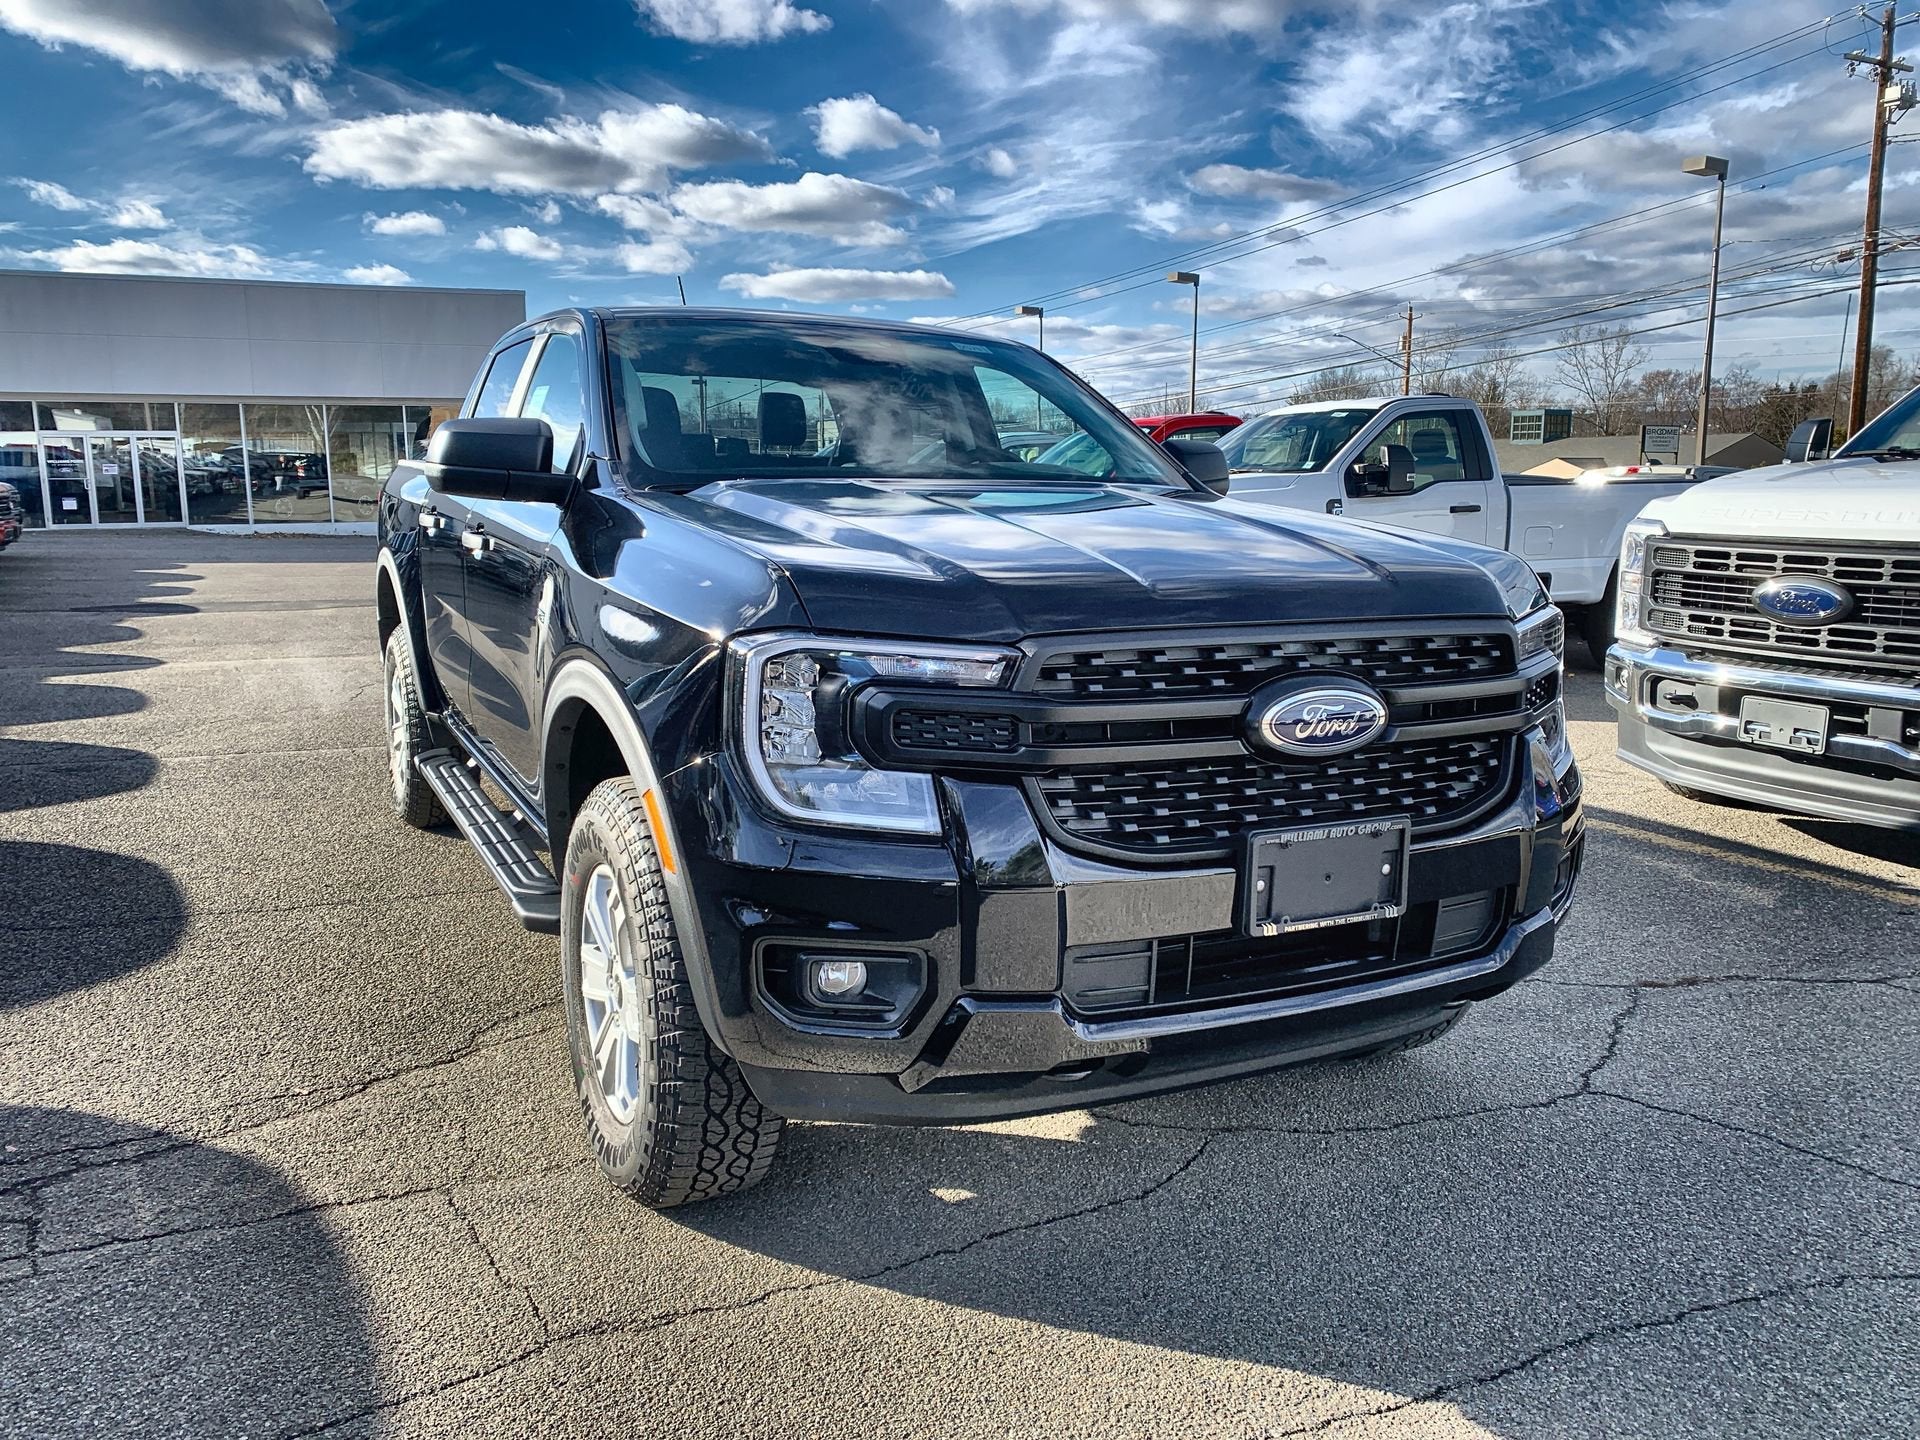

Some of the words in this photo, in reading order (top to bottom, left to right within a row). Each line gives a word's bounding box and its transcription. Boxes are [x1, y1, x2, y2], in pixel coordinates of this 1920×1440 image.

[1646, 428, 1678, 436] BROOME
[1774, 589, 1821, 612] Ford
[1295, 704, 1361, 739] Ford
[1330, 826, 1356, 838] AUTO
[568, 826, 616, 878] GOODYEAR
[1284, 922, 1319, 933] PARTNERING
[1320, 920, 1335, 928] WITH
[1346, 913, 1378, 924] COMMUNITY
[581, 1094, 634, 1168] WRANGLER
